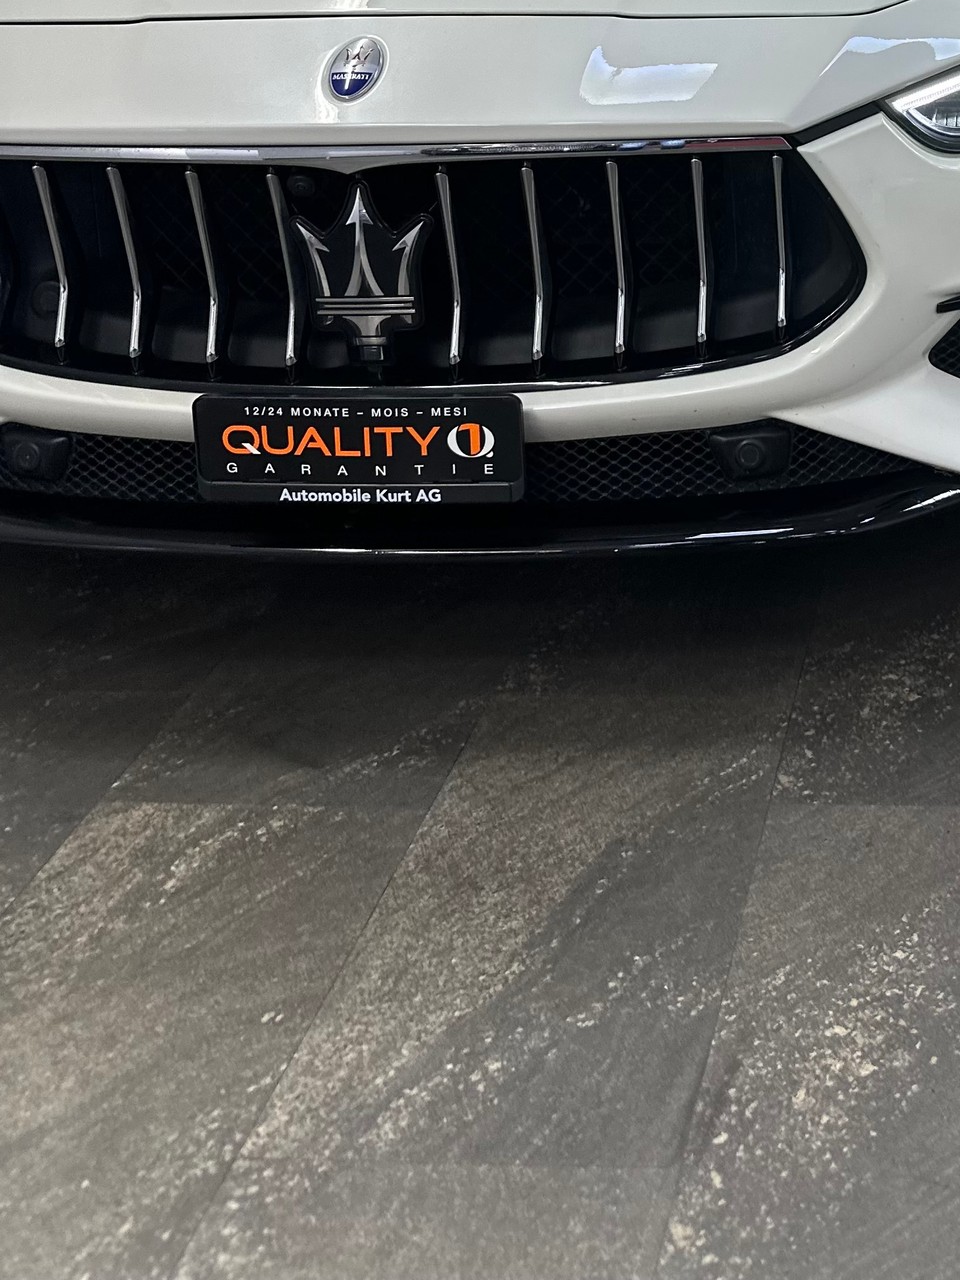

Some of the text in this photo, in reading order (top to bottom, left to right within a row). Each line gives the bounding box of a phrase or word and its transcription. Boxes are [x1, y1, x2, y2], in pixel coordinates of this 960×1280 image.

[244, 407, 283, 416] 12/24
[290, 408, 350, 417] MONATE
[371, 408, 409, 417] MOIS
[431, 407, 468, 417] MESI
[222, 424, 441, 457] QUALITY
[226, 462, 494, 477] GARANTIE
[279, 487, 442, 503] Automobile Kurt AG
